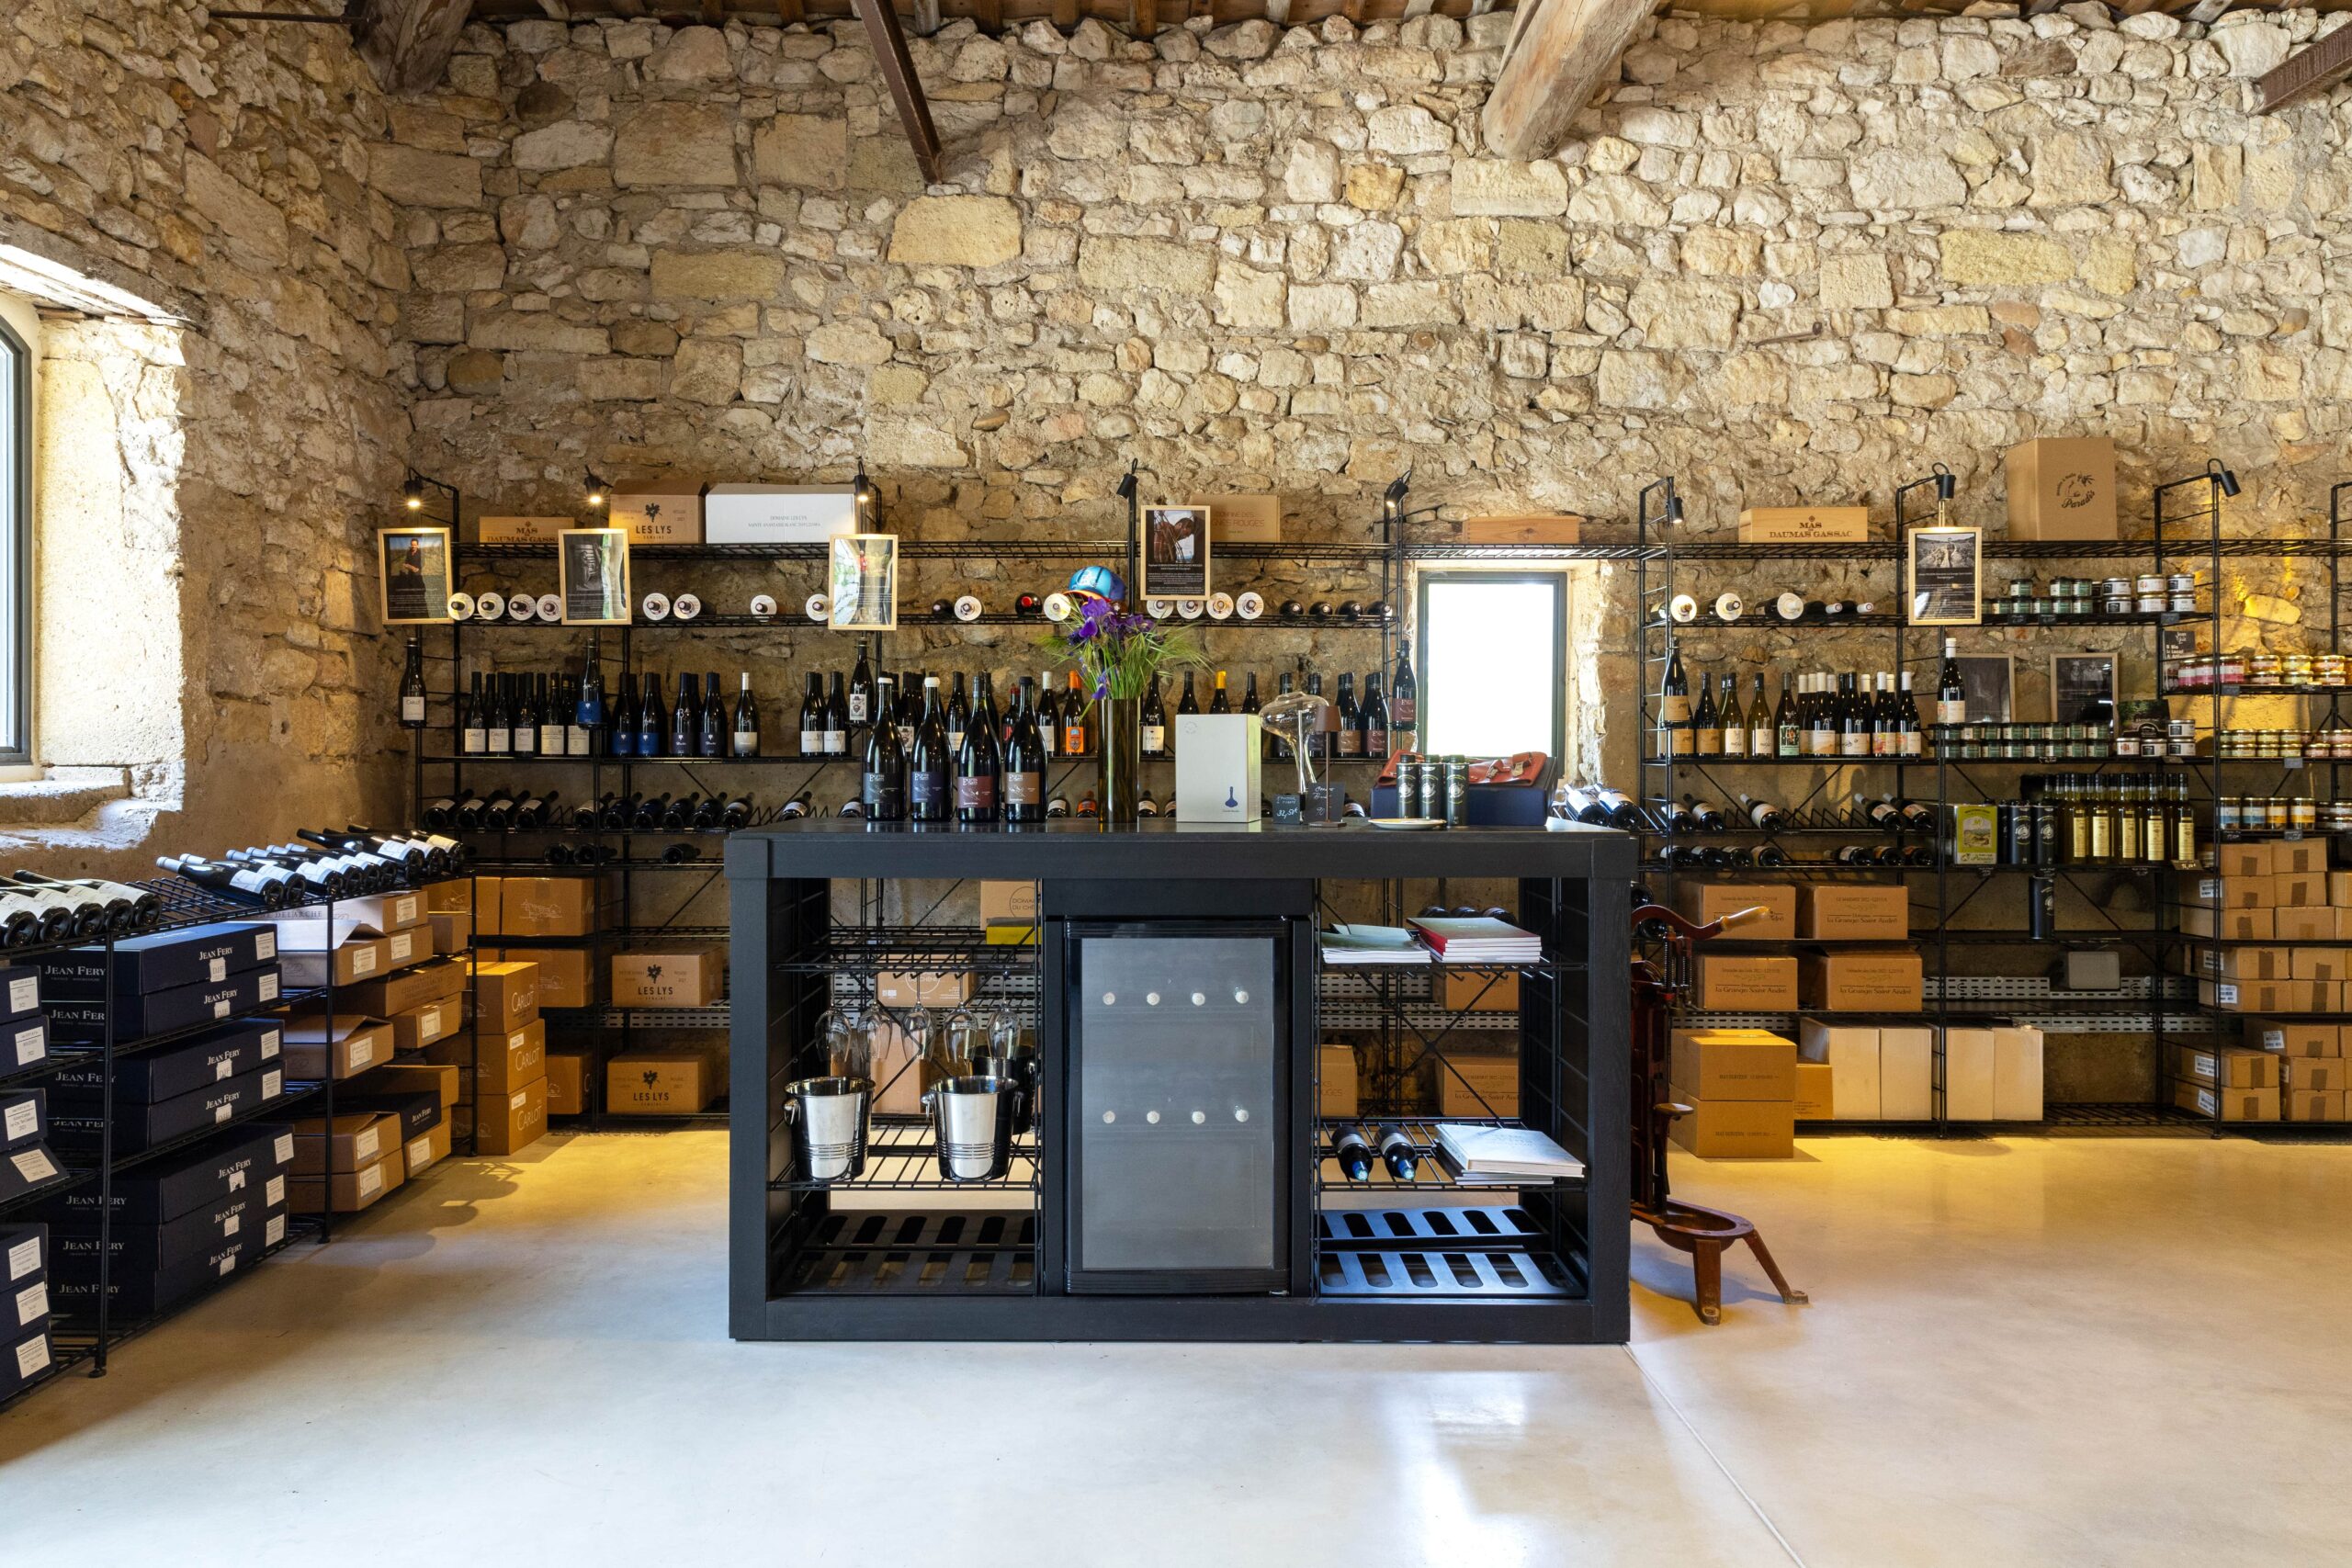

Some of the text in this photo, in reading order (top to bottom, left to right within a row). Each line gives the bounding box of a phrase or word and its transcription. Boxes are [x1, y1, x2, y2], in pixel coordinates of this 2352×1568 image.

[2061, 490, 2095, 508] Paradis
[636, 525, 672, 534] LES LYS
[199, 947, 233, 960] JEAN FERY
[45, 965, 106, 976] JEAN FERY
[204, 989, 238, 1004] JEAN FERY
[638, 986, 673, 995] LES LYS
[512, 990, 535, 1012] CARLOT
[51, 1010, 105, 1020] JEAN FER
[207, 1049, 241, 1065] JEAN FERY
[515, 1047, 540, 1071] CARLOT
[56, 1072, 116, 1083] JEAN FEY
[205, 1091, 241, 1110] JEAN FERY
[634, 1092, 669, 1101] LES LYS
[517, 1105, 543, 1131] CARLOT
[218, 1158, 252, 1179] JEAN FERY
[66, 1195, 95, 1205] JEAN
[214, 1201, 246, 1223] JEAN FERY
[63, 1241, 125, 1250] JEAN FRY
[209, 1242, 243, 1265] JEAN FERY
[59, 1284, 120, 1293] JEAN FRY
